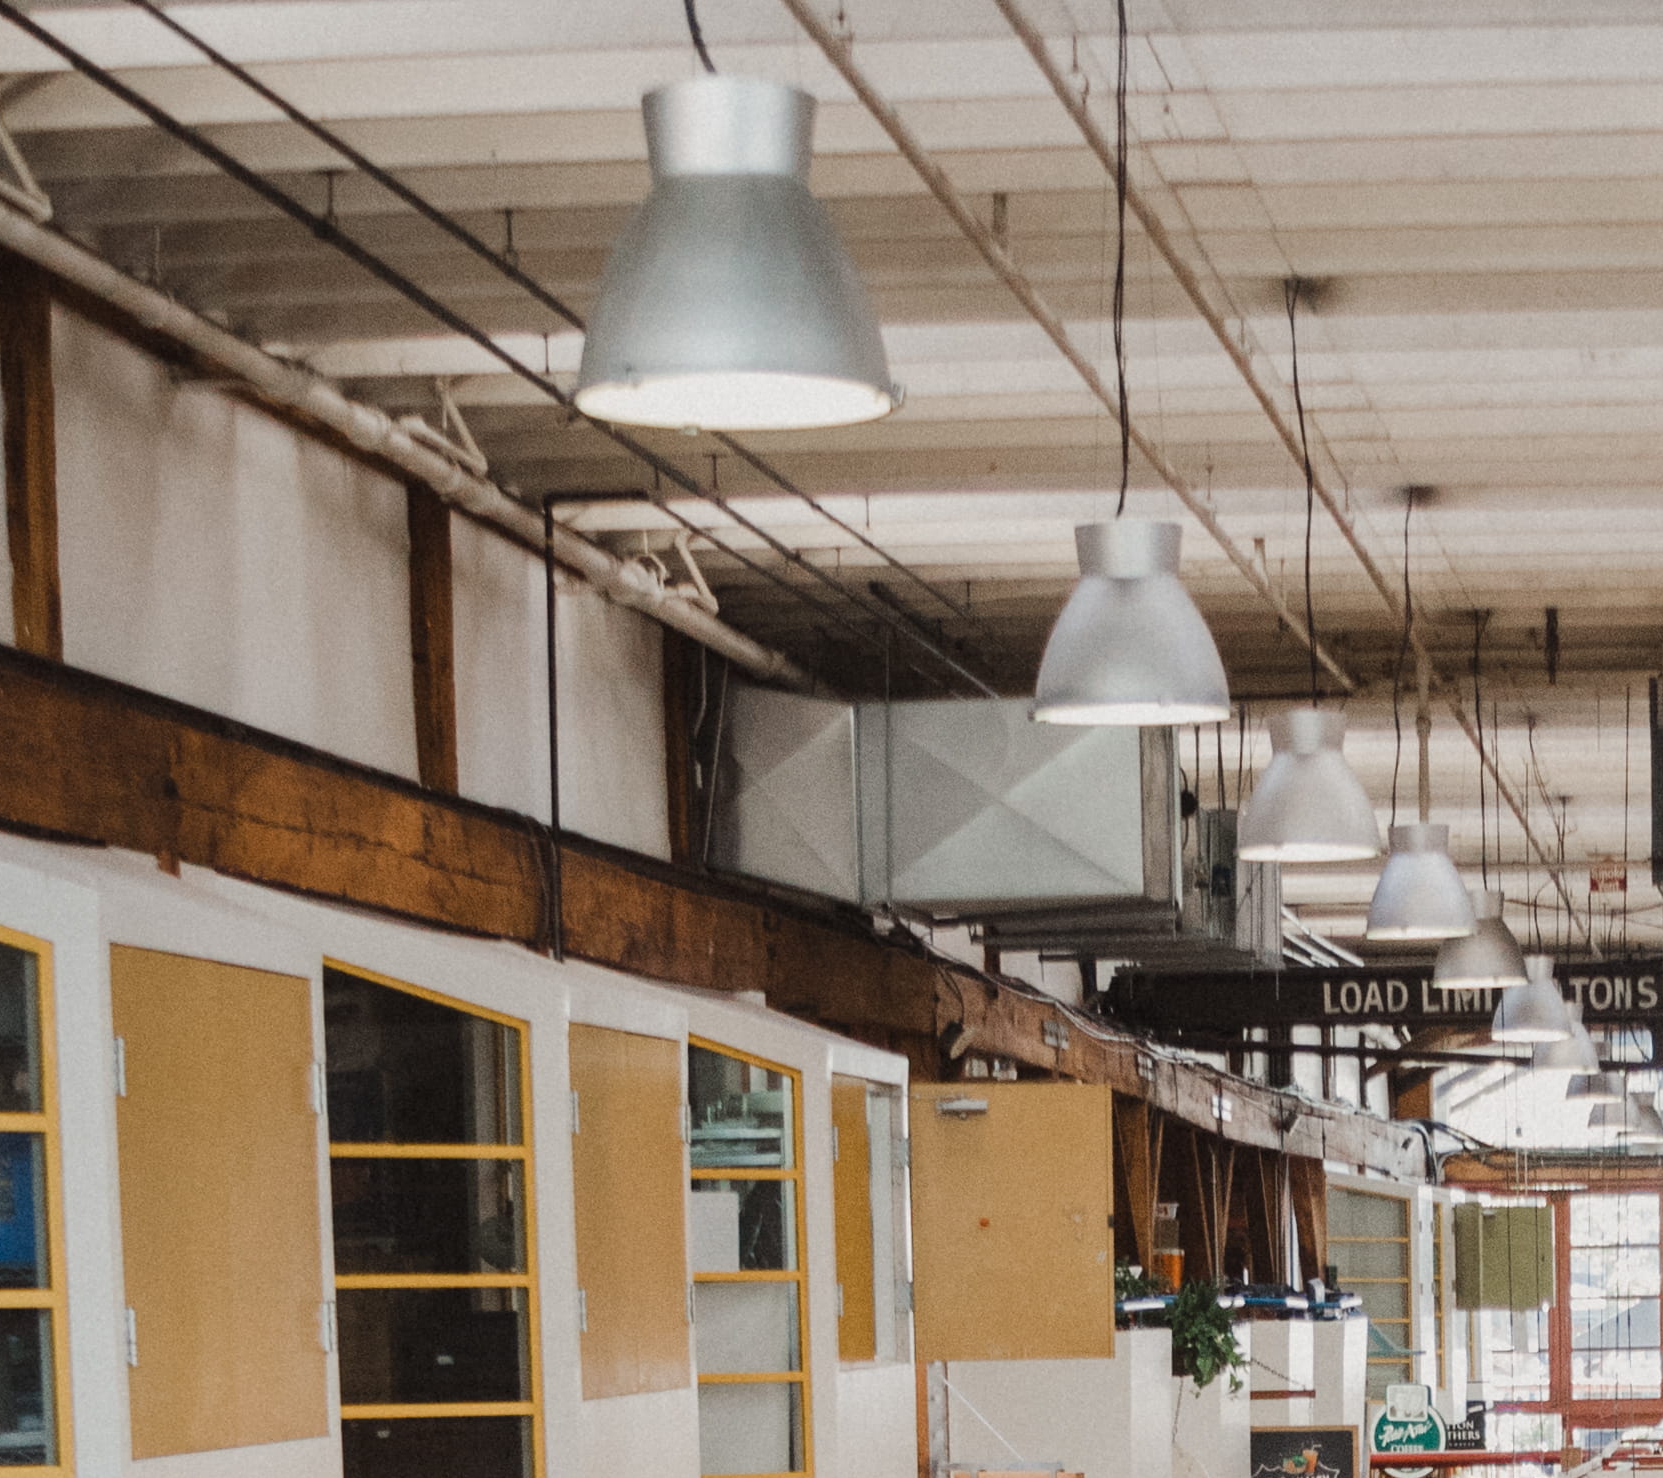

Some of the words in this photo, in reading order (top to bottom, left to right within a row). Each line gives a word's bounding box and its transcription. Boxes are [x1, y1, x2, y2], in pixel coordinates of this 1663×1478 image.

[1323, 980, 1408, 1014] LOAD
[1422, 979, 1494, 1013] LIMI
[1570, 977, 1658, 1010] TONS
[1447, 1431, 1480, 1440] THERS
